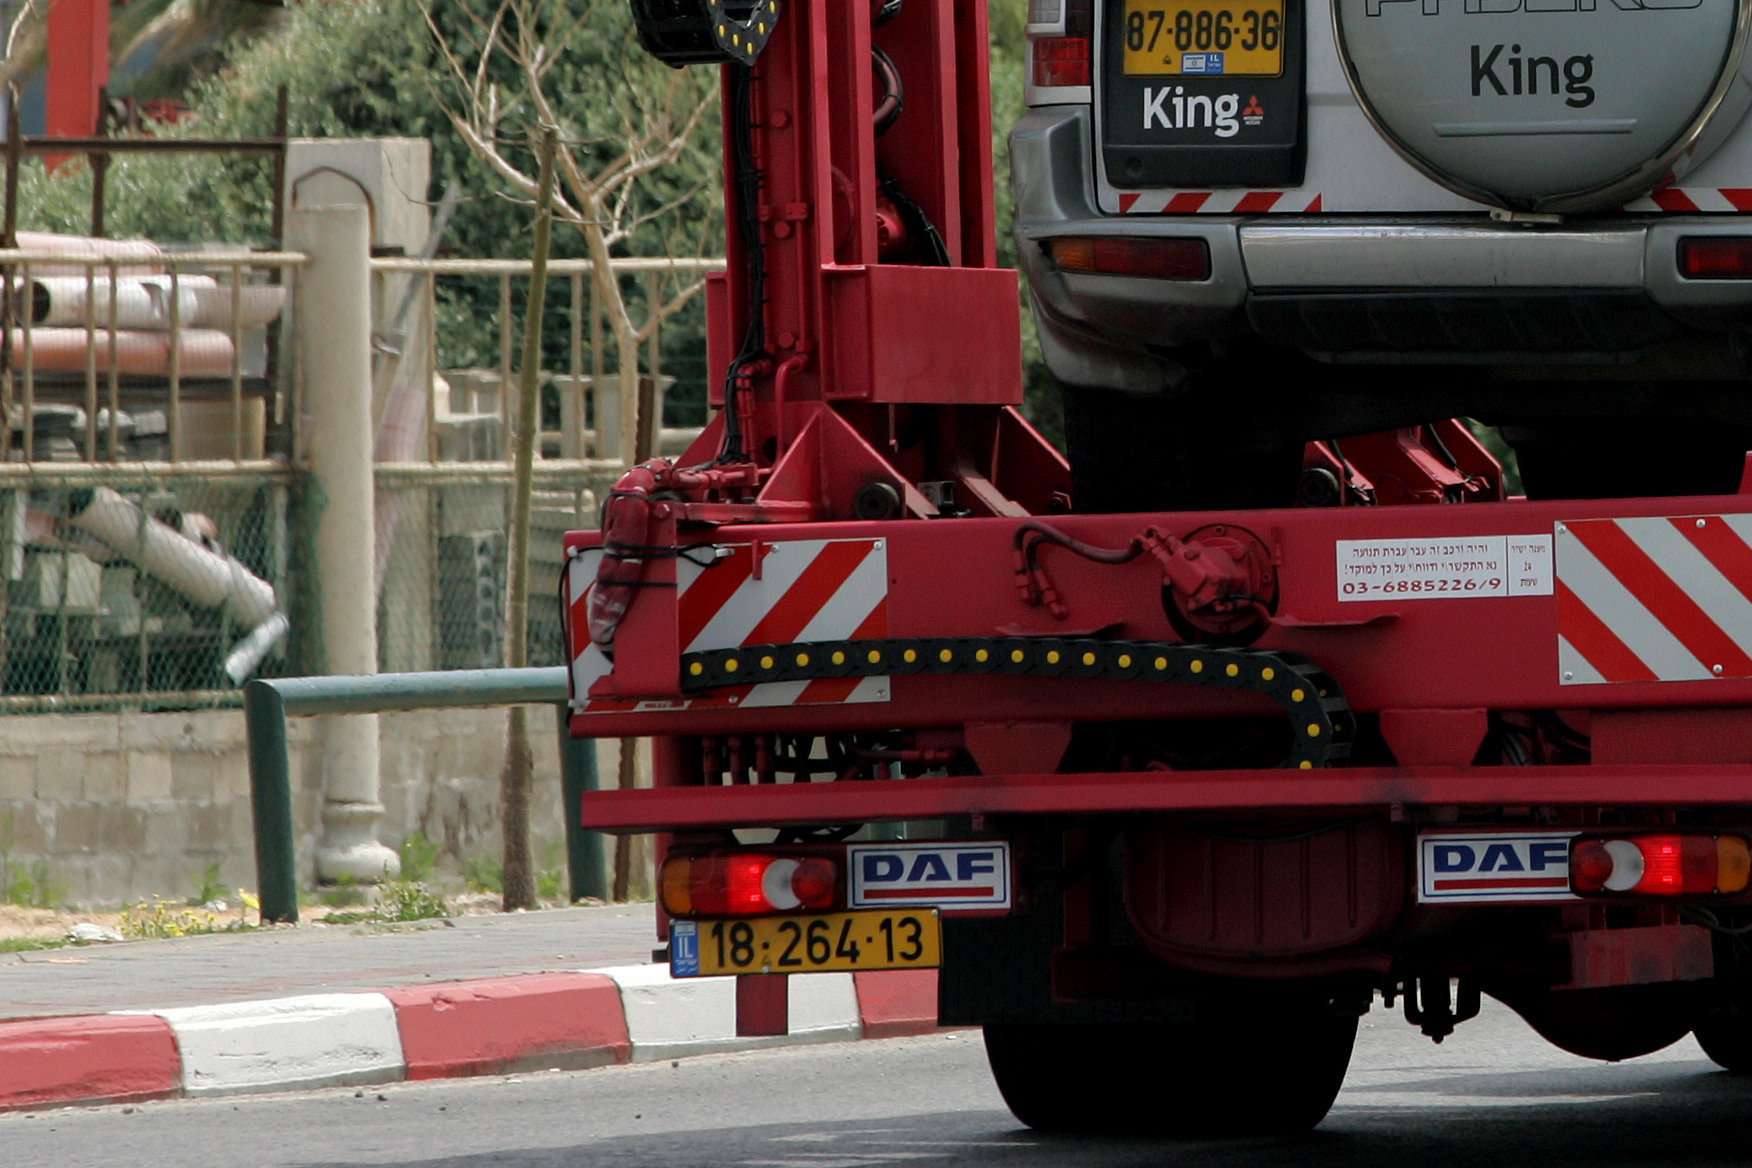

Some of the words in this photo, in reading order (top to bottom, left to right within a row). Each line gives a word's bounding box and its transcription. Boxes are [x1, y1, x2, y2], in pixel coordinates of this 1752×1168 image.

[1210, 54, 1219, 62] IL
[1470, 44, 1595, 109] King
[1143, 86, 1240, 138] King
[1380, 564, 1392, 576] כך
[1394, 563, 1406, 573] על
[1486, 561, 1497, 570] נא
[1343, 577, 1502, 595] 03-6885226/9
[863, 852, 995, 883] DAF
[1433, 842, 1568, 873] DAF
[678, 936, 694, 959] IL
